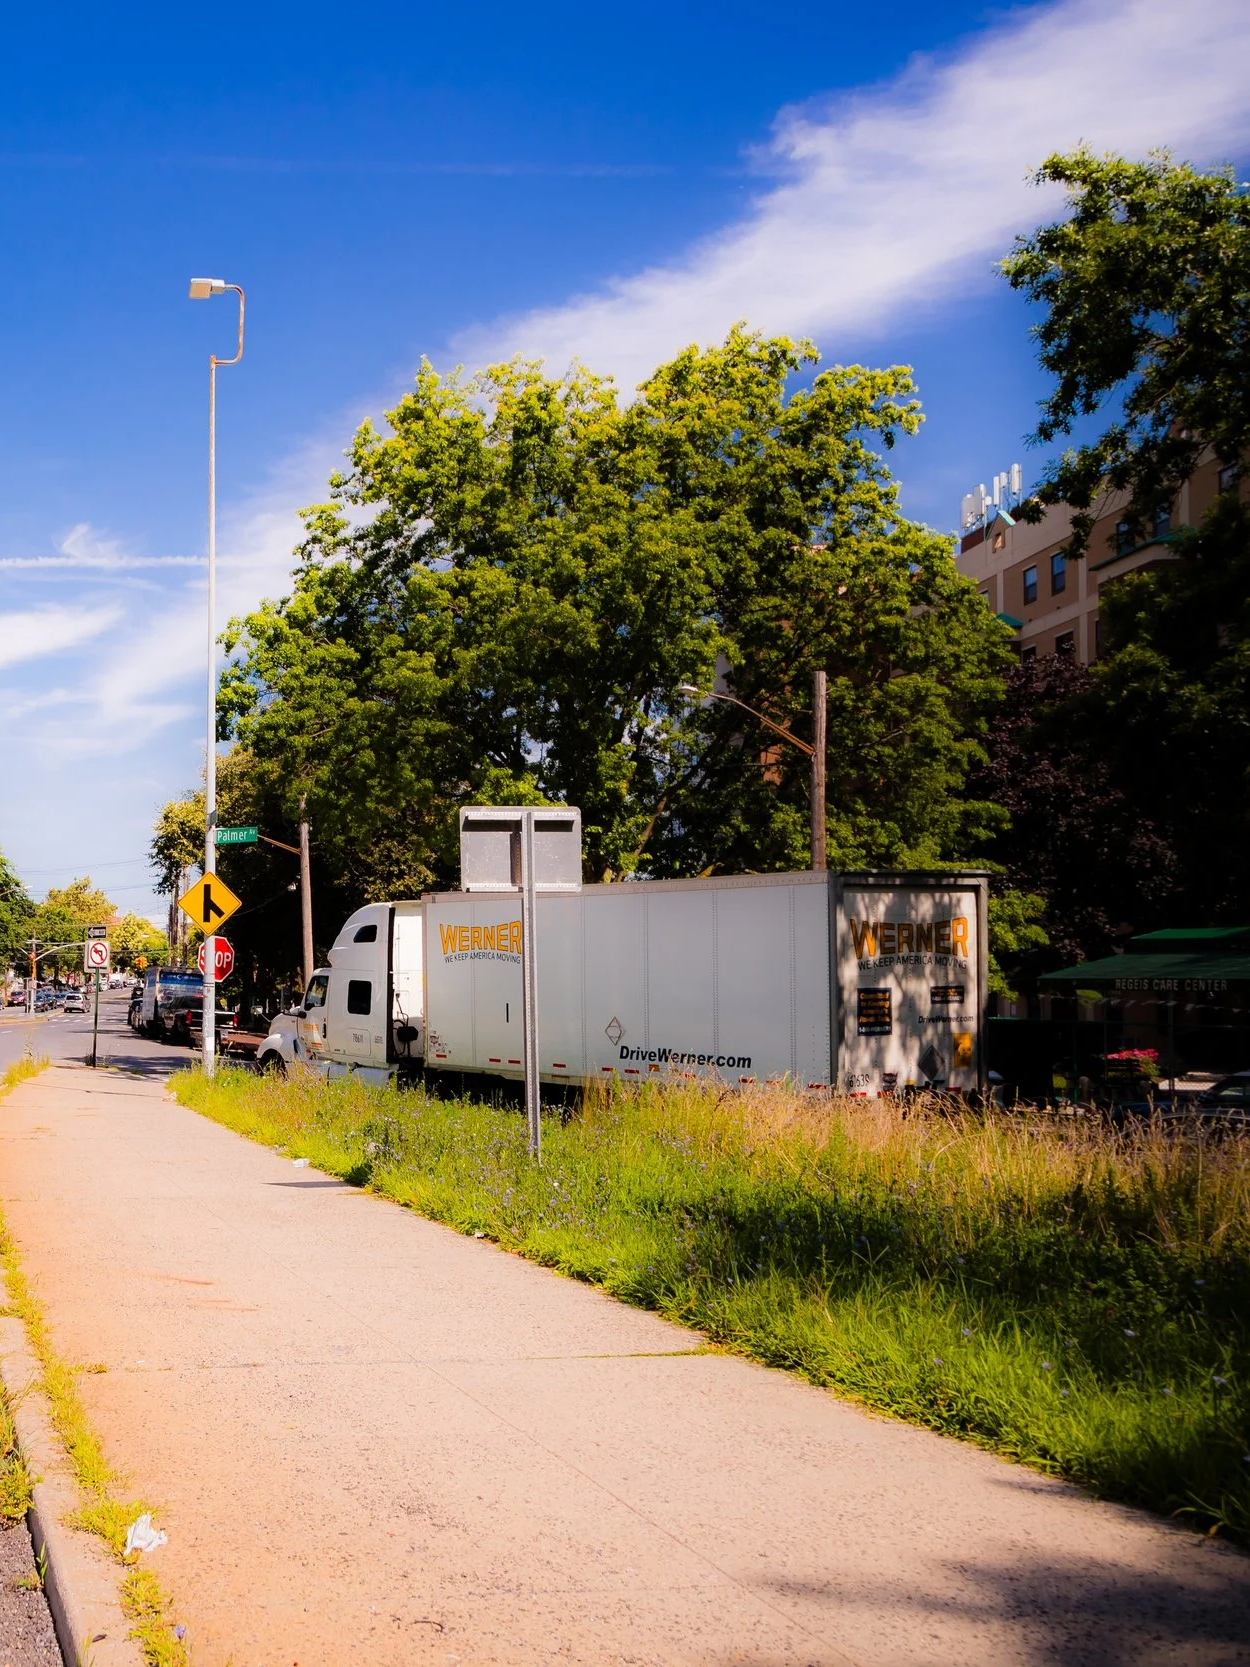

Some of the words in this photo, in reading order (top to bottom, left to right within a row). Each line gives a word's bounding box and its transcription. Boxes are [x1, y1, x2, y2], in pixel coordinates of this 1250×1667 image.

[217, 830, 248, 841] Palmer
[439, 920, 522, 955] WERNER
[850, 916, 968, 960] WERNER
[200, 949, 232, 968] SOP
[454, 952, 469, 961] KEEP
[470, 951, 495, 960] AMERICA
[496, 952, 521, 964] MOVING
[858, 959, 871, 971] WE
[873, 956, 895, 967] KEEP
[897, 955, 933, 965] AMERICA
[934, 956, 967, 969] MOVING
[1115, 979, 1149, 990] REGEIS
[1152, 979, 1179, 991] CARE
[1184, 979, 1228, 991] CENTER
[918, 1015, 974, 1024] DriveWerner.com
[619, 1045, 752, 1068] DriveWerner.com
